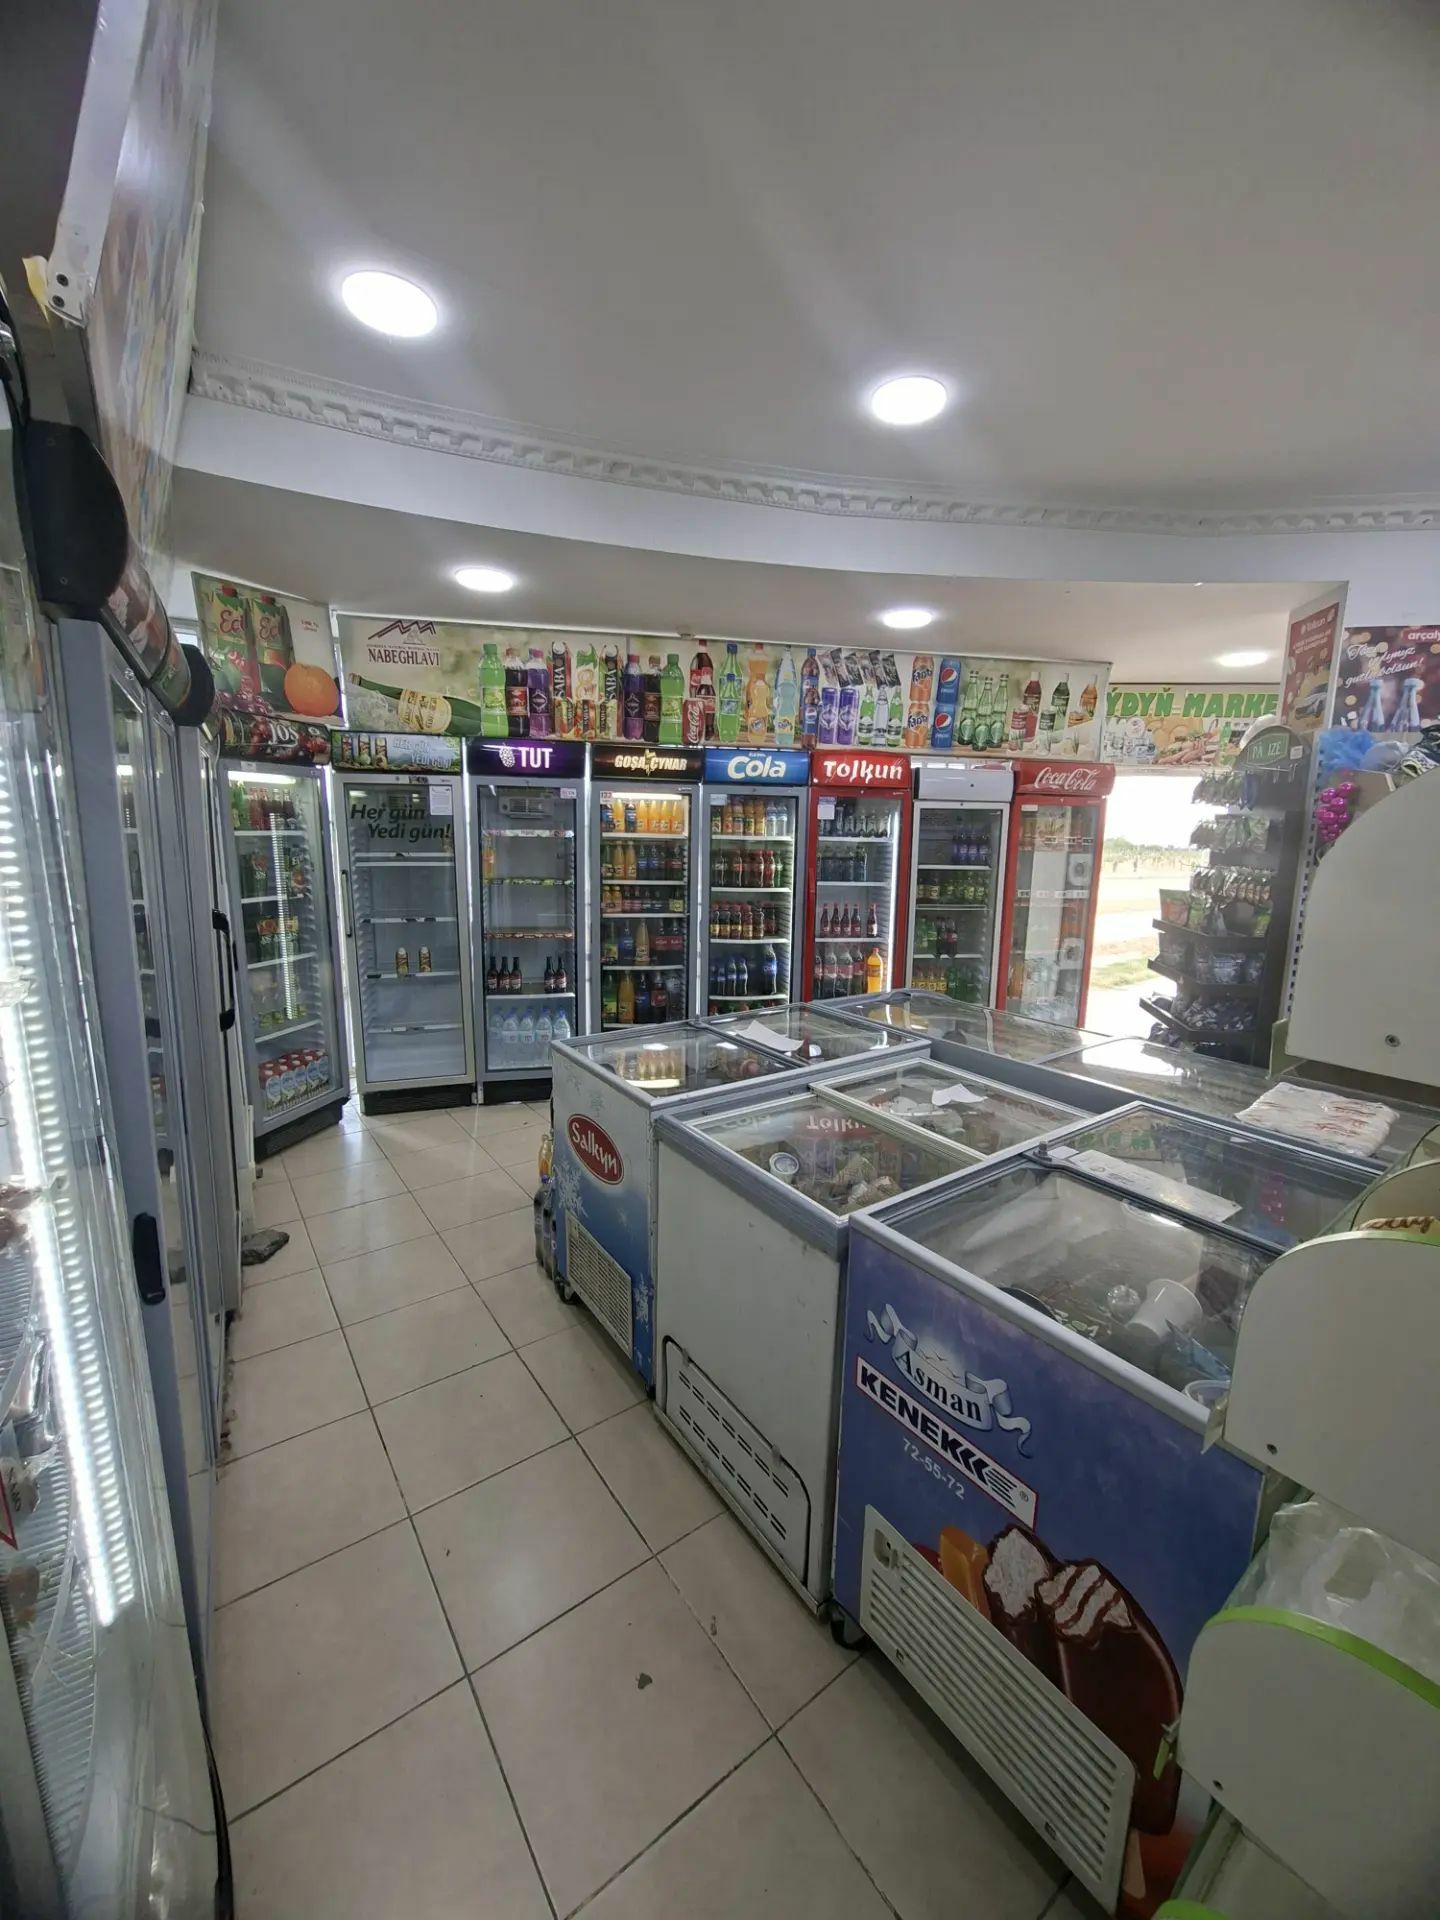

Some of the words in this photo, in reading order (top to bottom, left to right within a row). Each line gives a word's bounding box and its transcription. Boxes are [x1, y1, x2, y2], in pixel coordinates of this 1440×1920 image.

[368, 648, 439, 665] NABEGHLAVI
[518, 748, 553, 769] TUT
[728, 755, 787, 779] Cola
[823, 758, 903, 784] Tolkun
[350, 803, 385, 821] Her
[389, 804, 426, 824] gün
[368, 823, 406, 839] Yedi
[408, 823, 451, 843] gün!
[572, 1122, 618, 1175] Salkyn
[896, 1351, 983, 1423] Asman
[902, 1439, 966, 1501] 72-55-72
